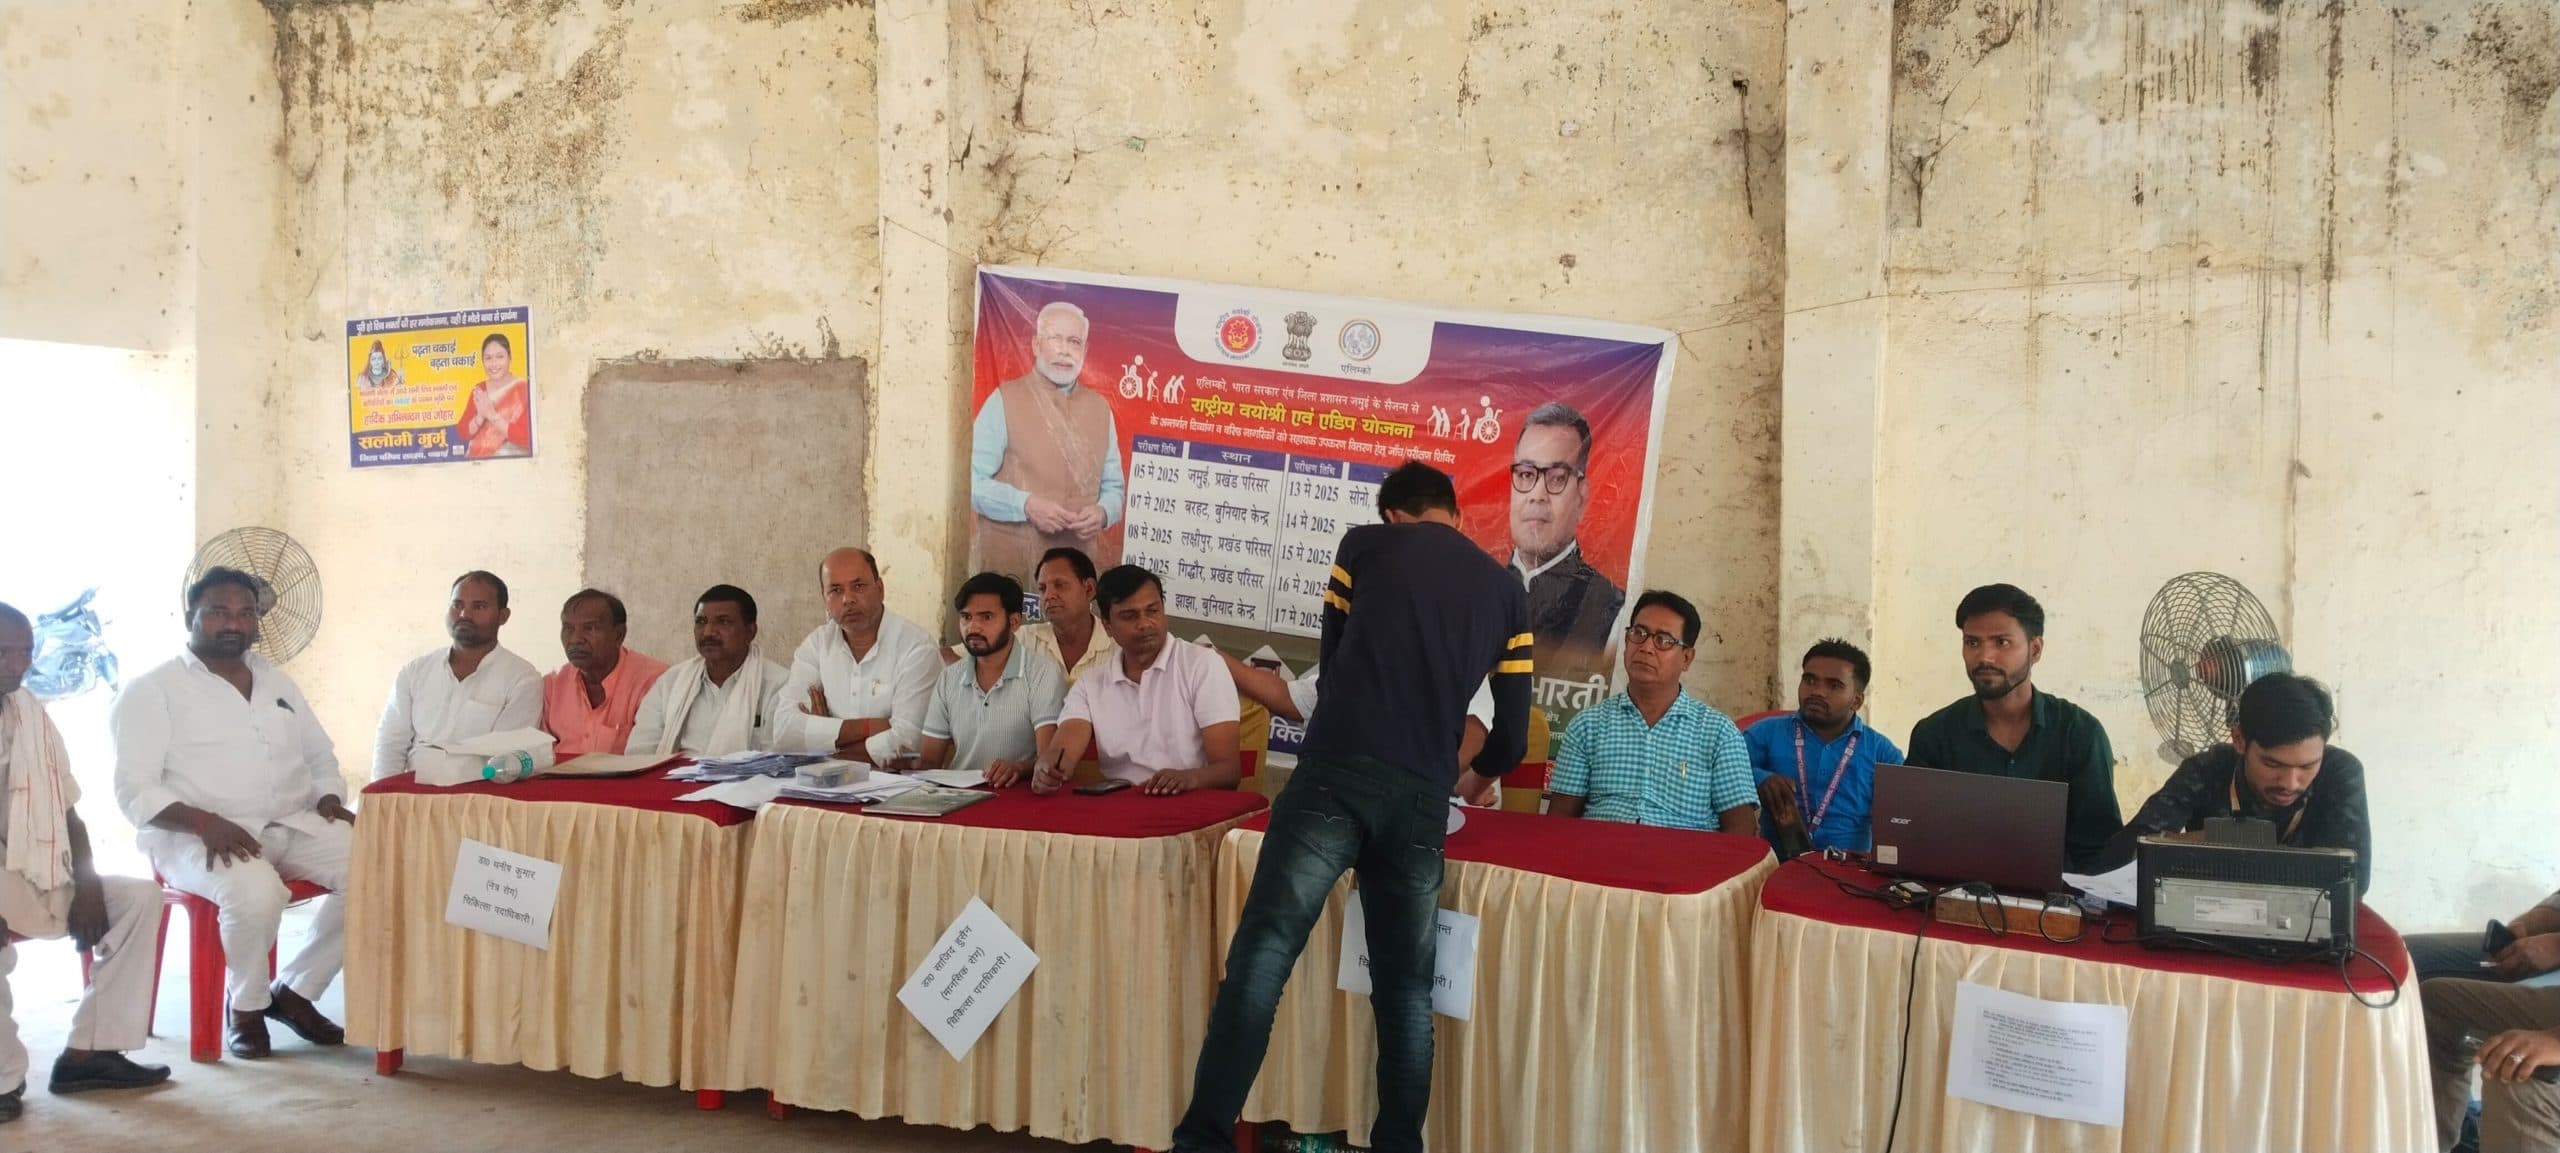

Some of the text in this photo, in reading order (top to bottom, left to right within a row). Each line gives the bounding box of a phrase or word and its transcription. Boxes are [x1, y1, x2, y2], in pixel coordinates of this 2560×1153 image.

[1340, 364, 1371, 375] एलिम्को
[1232, 382, 1250, 393] भारत
[1253, 384, 1279, 397] सरकार
[1297, 388, 1317, 400] जिला
[1319, 392, 1347, 404] प्रशासन
[1372, 396, 1381, 409] के
[1411, 401, 1420, 415] से
[1191, 394, 1415, 438] राष्ट्रीय वयोश्री एवं एडिप योजना
[358, 431, 413, 449] सलोमी
[1137, 440, 1177, 456] परीक्षण तिथि
[1150, 412, 1158, 426] के
[1216, 425, 1222, 434] व
[1277, 430, 1287, 442] को
[1433, 449, 1456, 464] शिविर
[1221, 451, 1253, 464] स्थान
[1134, 463, 1146, 479] 05
[1157, 466, 1179, 483] 2025
[1294, 461, 1336, 476] परीक्षण तिथि
[1215, 468, 1239, 489] प्रखंड
[1241, 472, 1271, 493] परिसर
[1289, 480, 1300, 497] 13
[1314, 484, 1339, 502] 2025
[1130, 493, 1142, 508] 07
[1153, 497, 1176, 513] 2025
[1215, 501, 1247, 524] बुनियाद
[1250, 504, 1270, 526] केन्द्र
[1128, 524, 1139, 539] 08
[1150, 528, 1172, 544] 2025
[1285, 513, 1297, 528] 14
[1311, 517, 1335, 534] 2025
[1218, 534, 1242, 552] प्रखंड
[1245, 537, 1272, 558] परिसर
[1281, 544, 1293, 560] 15
[1307, 548, 1332, 565] 2025
[1148, 558, 1170, 574] 2025
[1210, 565, 1234, 583] प्रखंड
[1237, 568, 1264, 589] परिसर
[1278, 576, 1289, 592] 16
[1303, 580, 1327, 597] 2025
[1175, 593, 1197, 613] झाझा,
[1201, 595, 1233, 616] बुनियाद
[1237, 598, 1256, 621] केन्द्र
[1274, 608, 1286, 623] 17
[1300, 612, 1323, 629] 2025
[1890, 817, 1912, 825] acer
[503, 885, 518, 899] रोग)
[934, 945, 956, 972] साजिद
[940, 946, 986, 1000] (मानसिक रोग)
